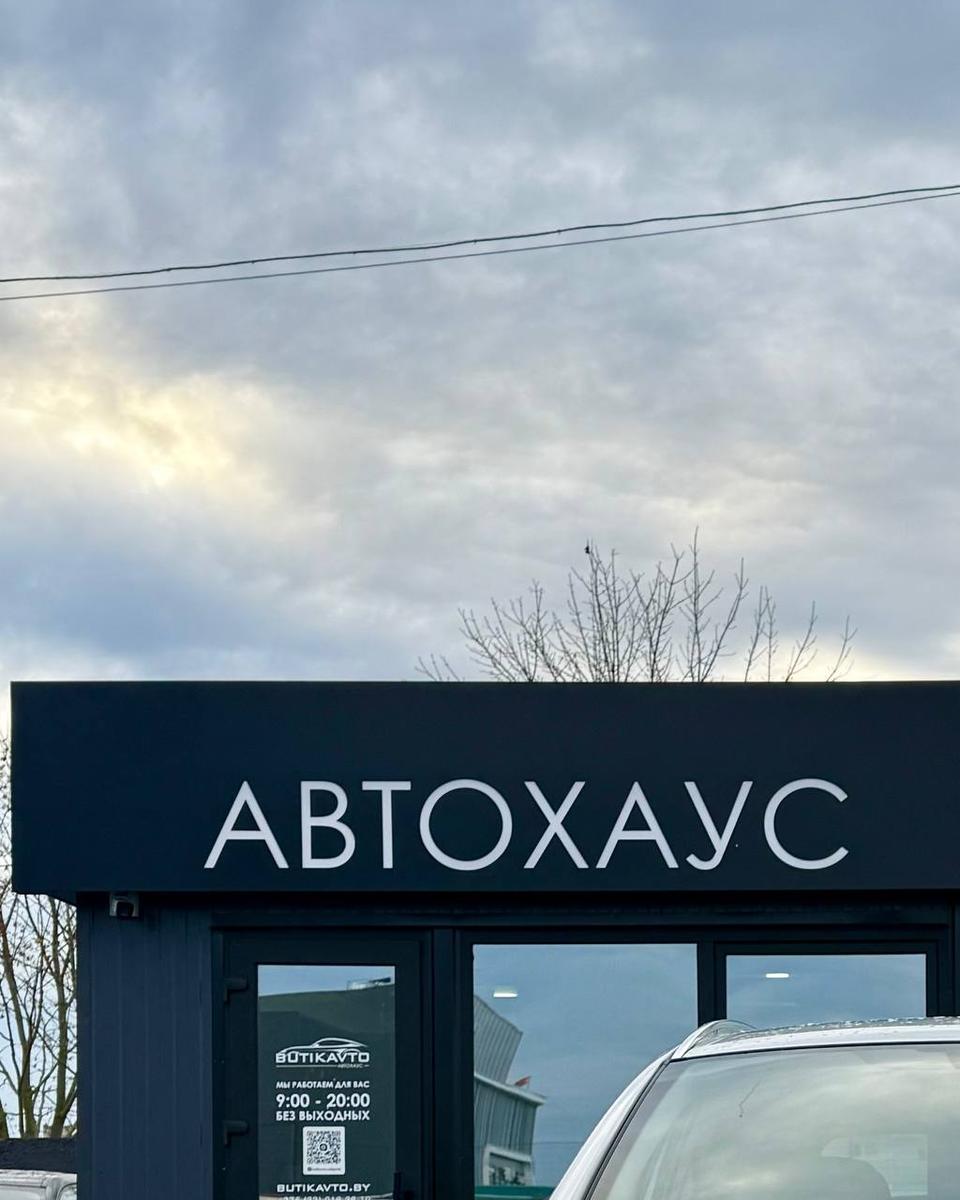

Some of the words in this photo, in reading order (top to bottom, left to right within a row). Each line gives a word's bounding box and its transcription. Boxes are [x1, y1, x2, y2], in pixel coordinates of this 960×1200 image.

[204, 778, 850, 870] АВТОХАУС
[276, 1051, 370, 1063] BUTIKAVTO
[276, 1081, 291, 1089] МЫ
[292, 1081, 334, 1089] РАБОТАЕМ
[334, 1081, 352, 1090] ДЛЯ
[353, 1080, 370, 1088] ВАС
[276, 1093, 310, 1108] 9:00
[326, 1093, 370, 1108] 20:00
[276, 1110, 296, 1121] БЕЗ
[299, 1110, 370, 1121] ВЫХОДНЫХ
[277, 1183, 371, 1192] BUTIKAVTO.BY
